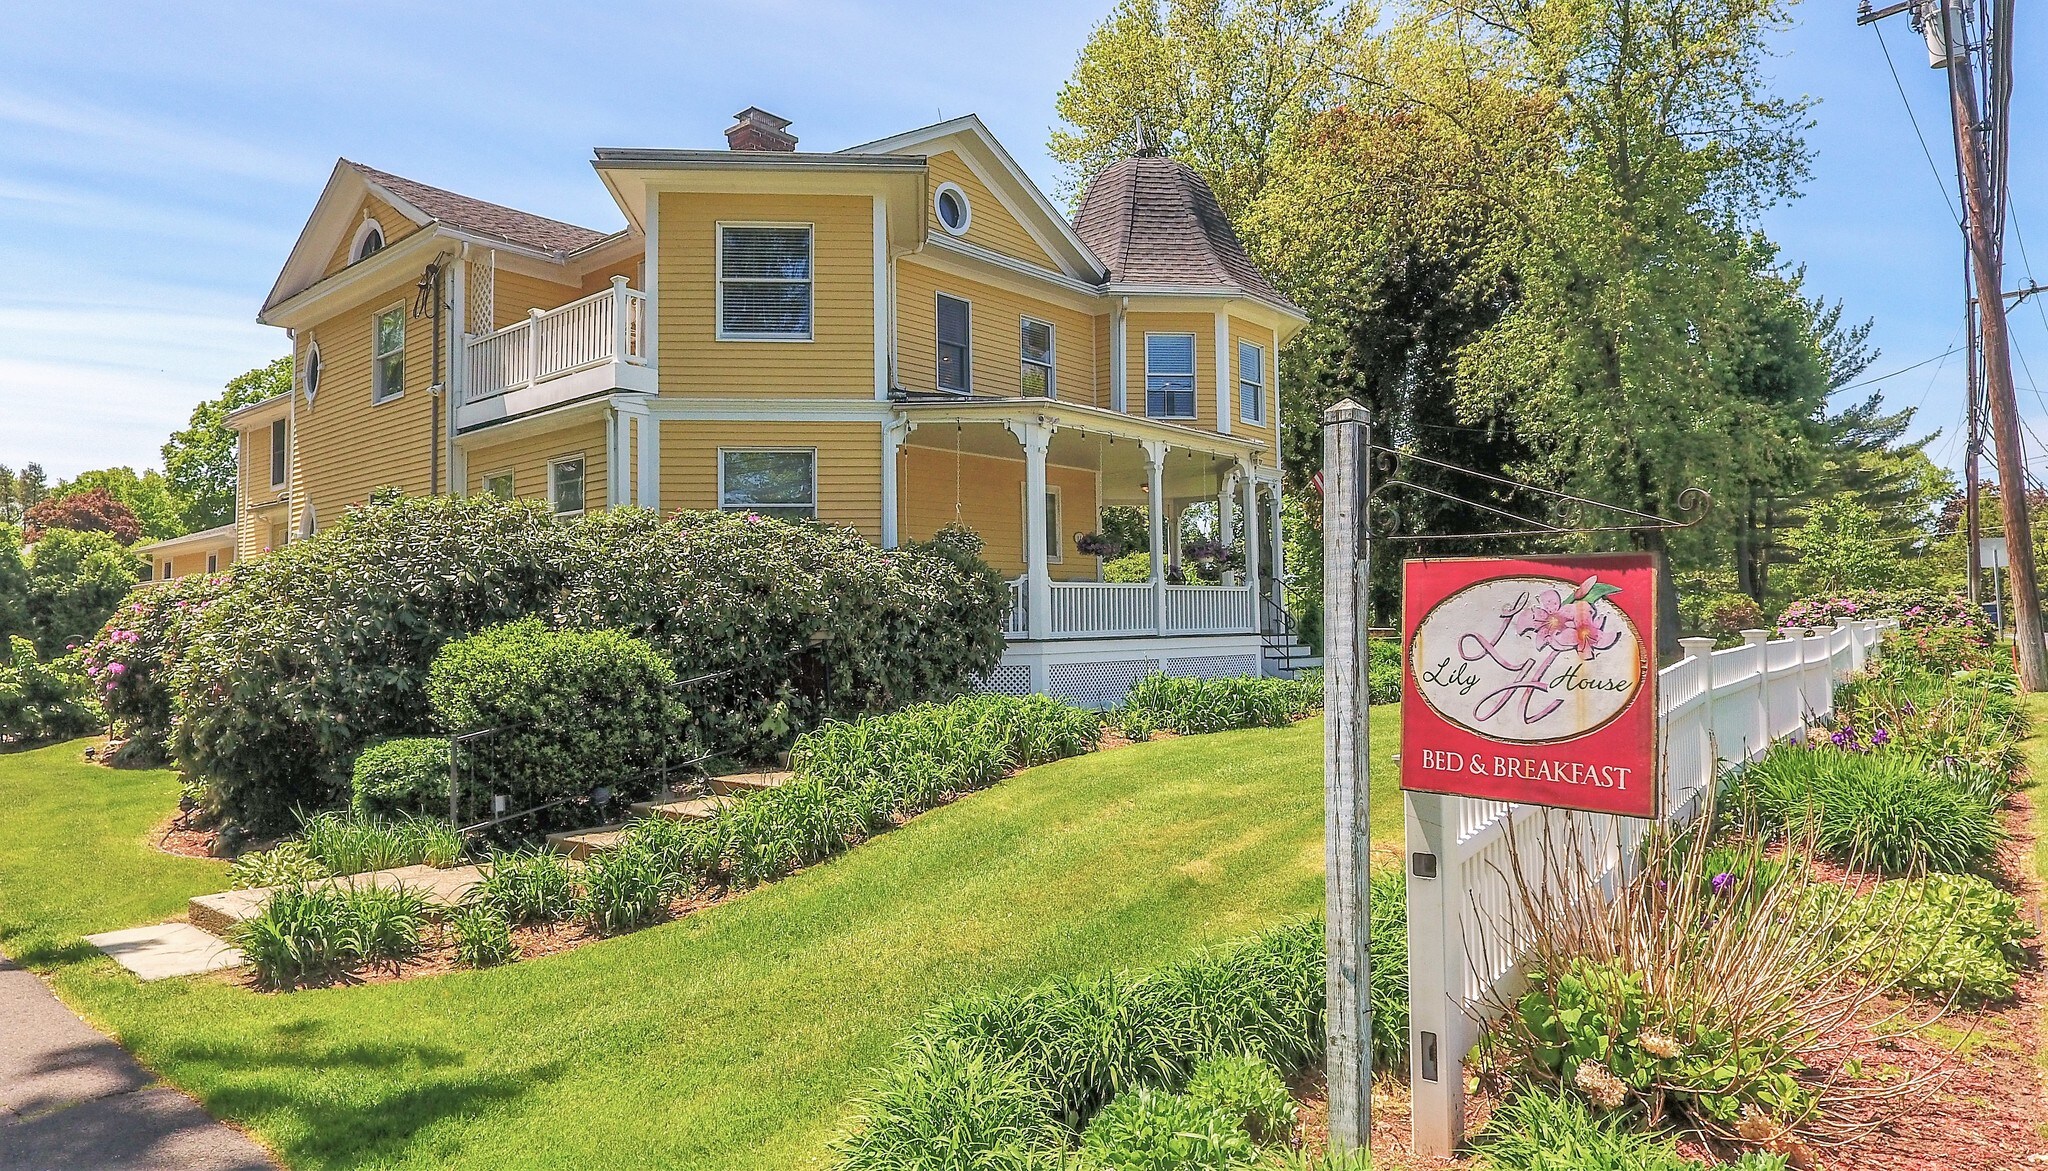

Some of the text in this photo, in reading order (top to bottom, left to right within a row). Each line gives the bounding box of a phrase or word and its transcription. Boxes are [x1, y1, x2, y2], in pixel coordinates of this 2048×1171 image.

[1422, 656, 1633, 696] Lily House
[1422, 749, 1632, 790] BED & BREAKFAST
